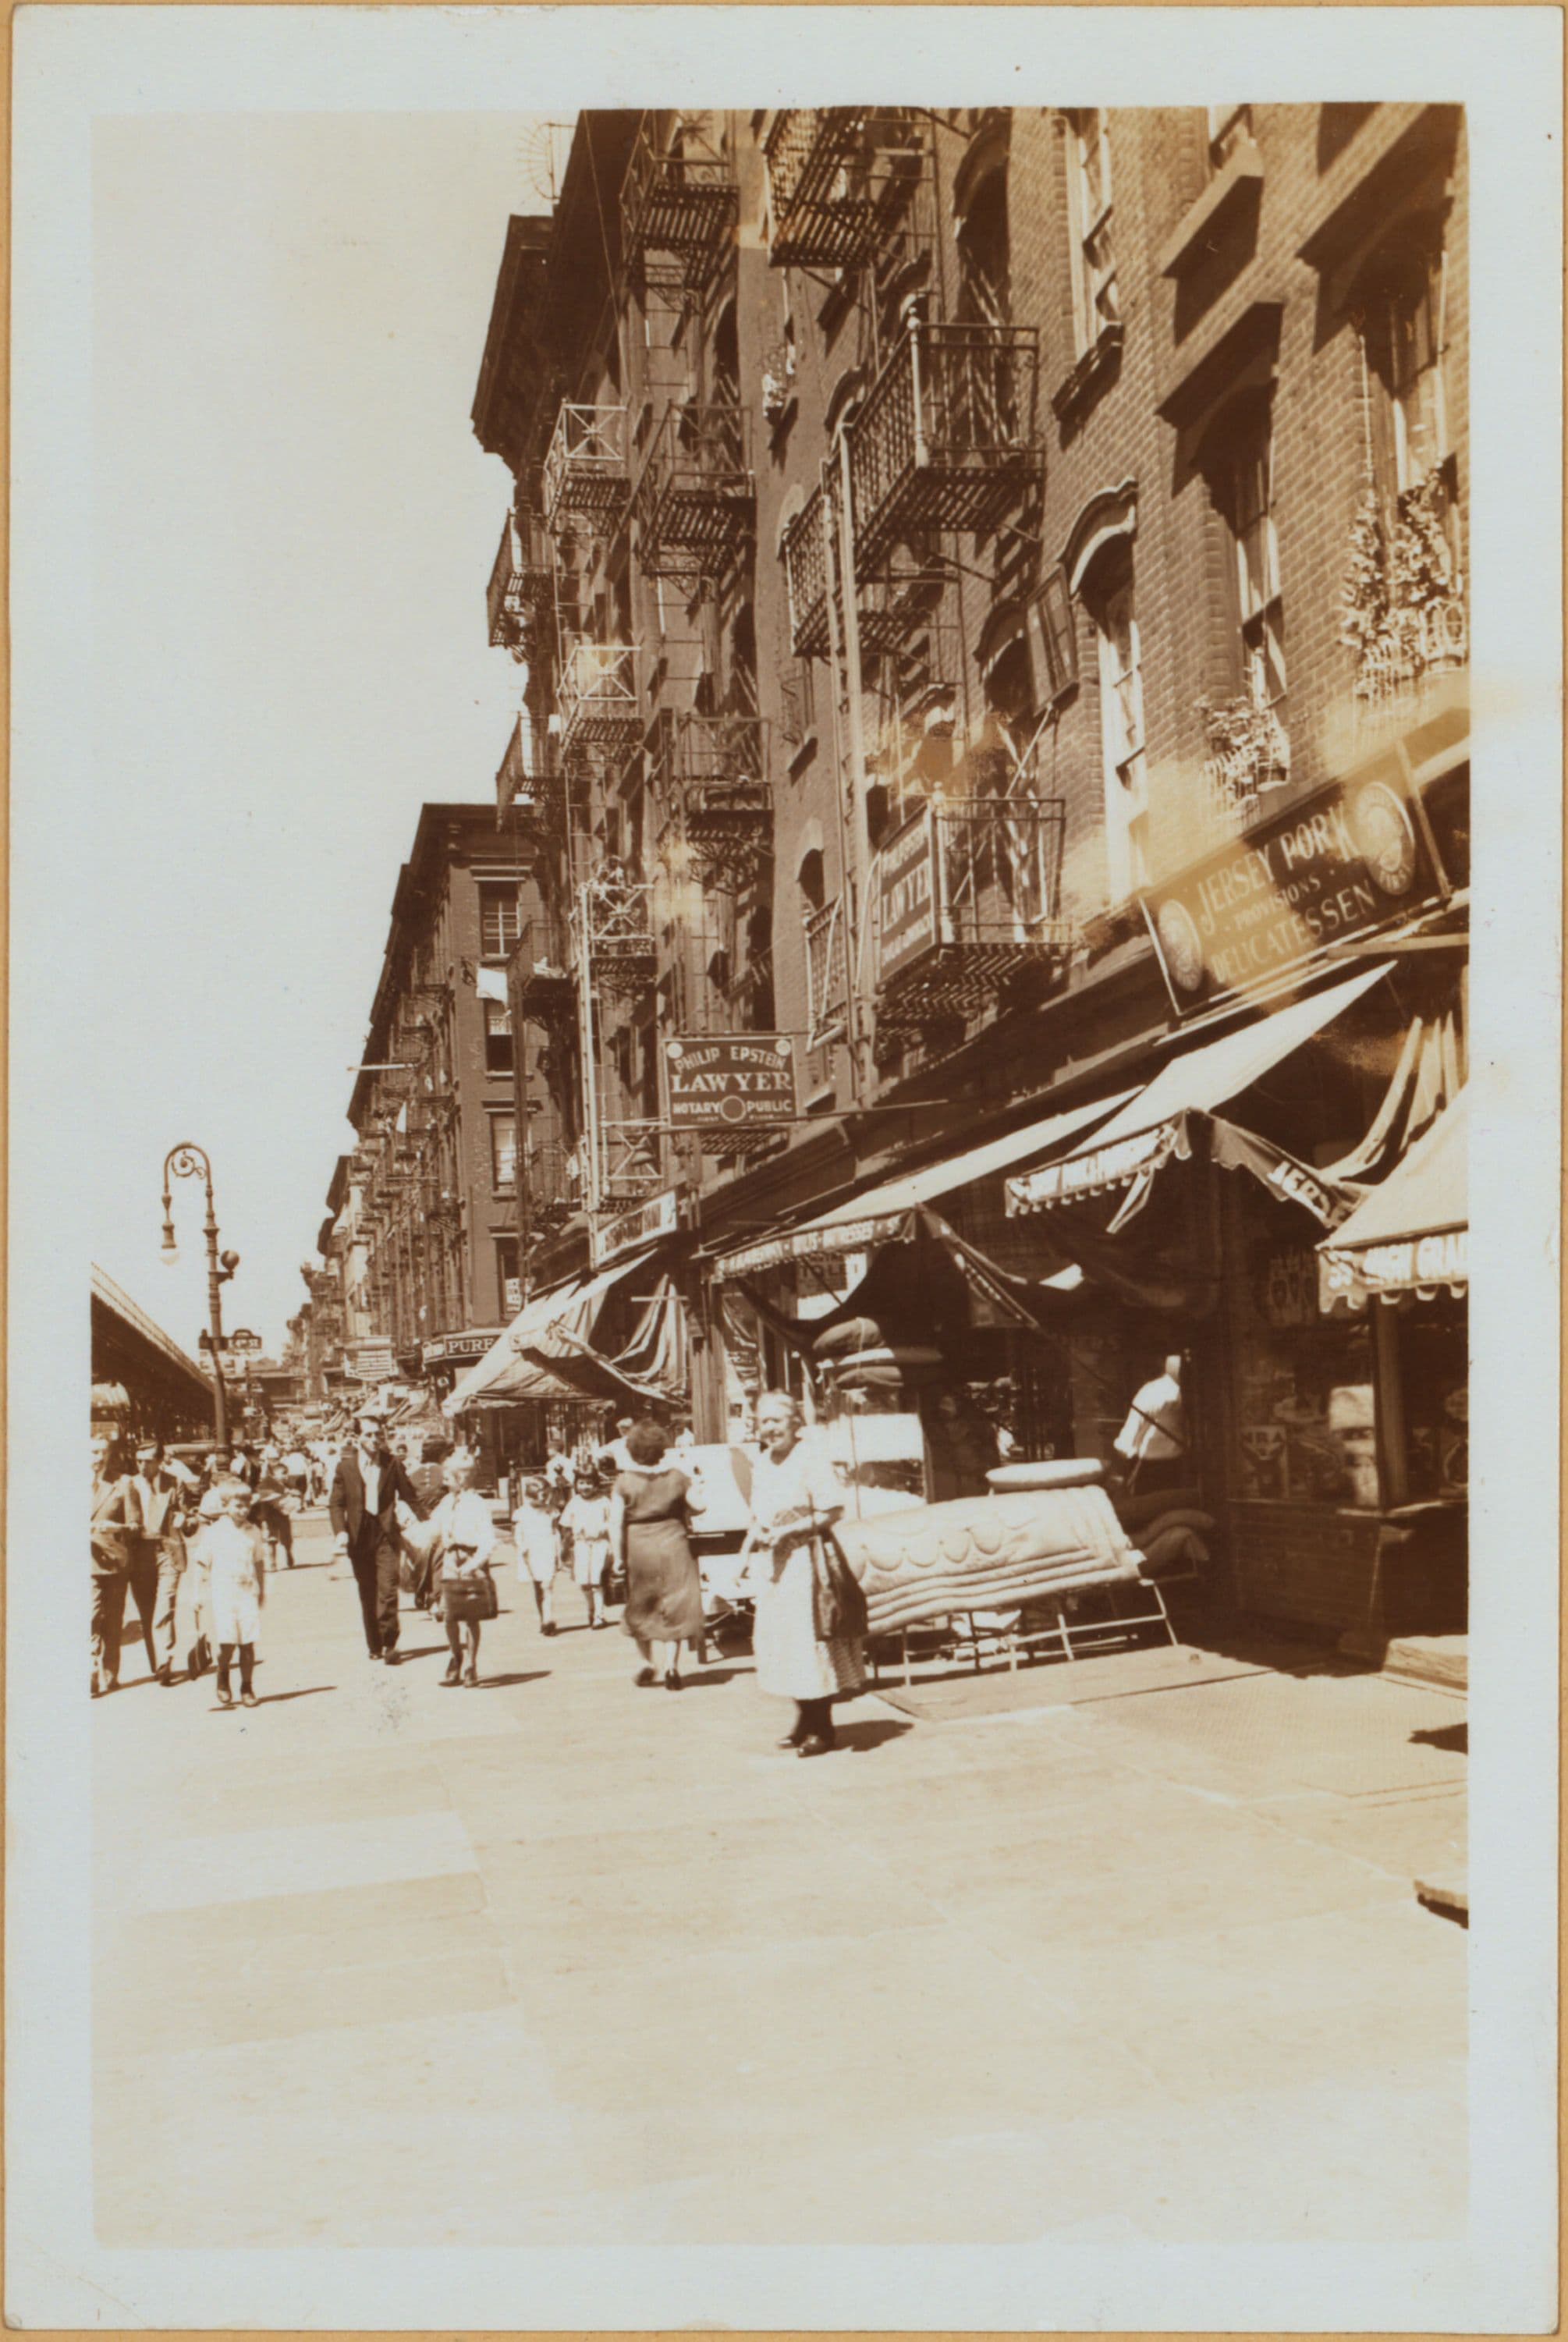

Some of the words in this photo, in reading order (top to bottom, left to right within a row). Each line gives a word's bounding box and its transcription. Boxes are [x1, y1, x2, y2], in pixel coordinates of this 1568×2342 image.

[1198, 843, 1275, 937] JERSEY
[1279, 800, 1361, 871] PORK
[1210, 878, 1376, 984] DELICATESSEN
[673, 1047, 720, 1073] PHILIP
[671, 1071, 793, 1093] LAWYER
[672, 1101, 720, 1114] NOTARY
[747, 1098, 793, 1112] PUBLIC
